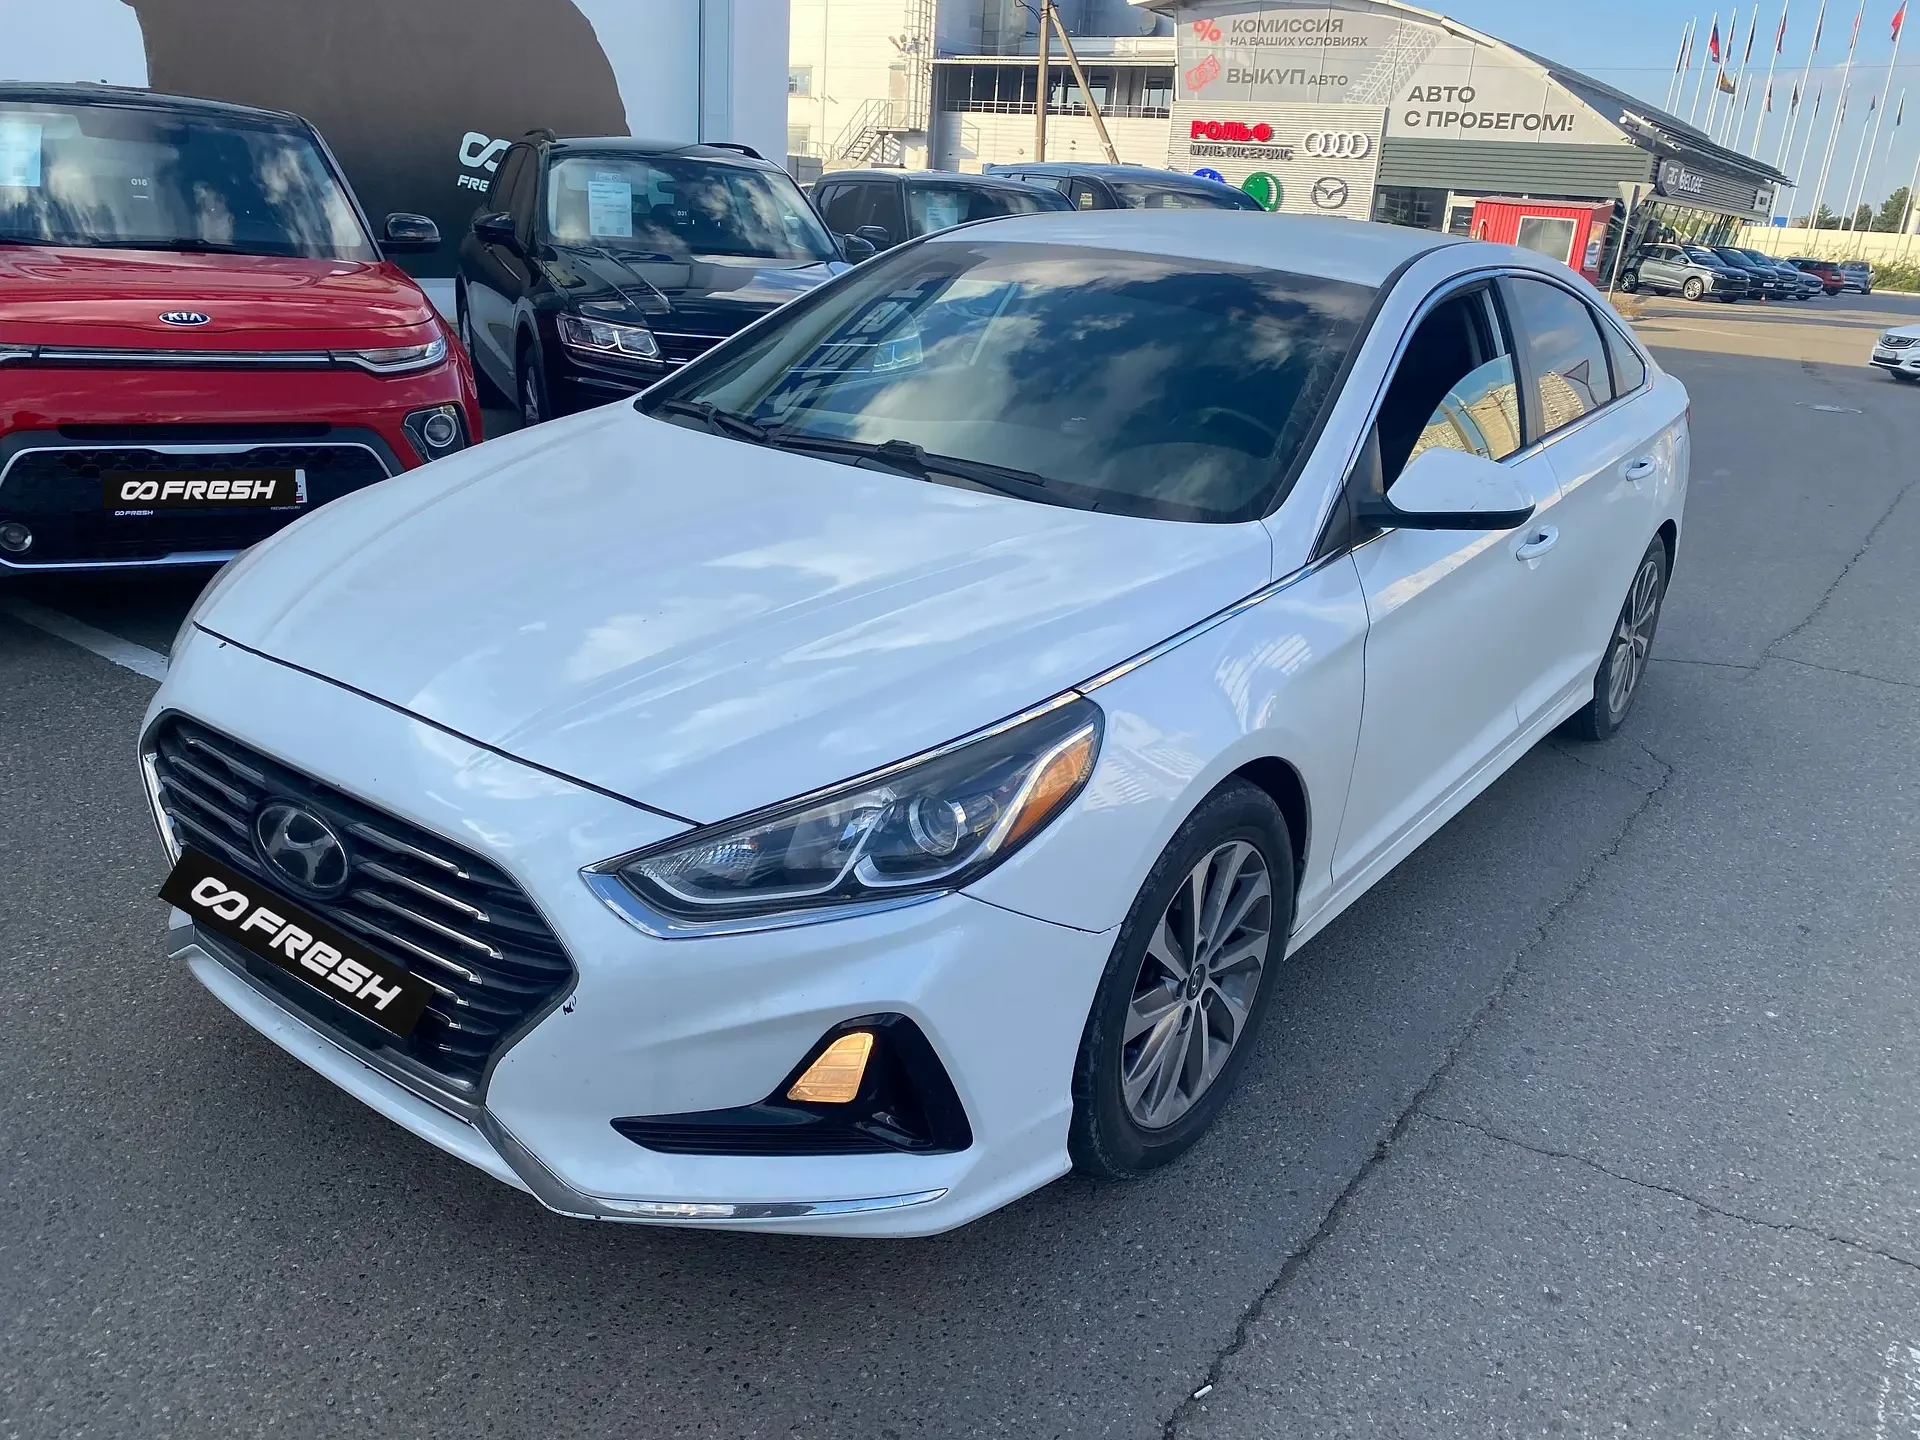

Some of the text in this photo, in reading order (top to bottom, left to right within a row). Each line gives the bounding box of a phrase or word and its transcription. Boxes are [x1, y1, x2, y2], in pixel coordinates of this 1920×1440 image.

[1232, 18, 1343, 33] КОМИССИЯ
[1230, 37, 1368, 46] НА ВАШИХ УСЛОВИЯХ
[1226, 68, 1348, 86] ВЫКУП АВТО
[1407, 85, 1476, 103] АВТО
[1404, 110, 1575, 132] С ПРОБЕГОМ!
[1190, 121, 1273, 142] РОЛЬФ
[1190, 144, 1294, 160] МУЛЬТИСЕРВИС
[457, 174, 490, 192] FRE
[168, 312, 203, 322] KIA
